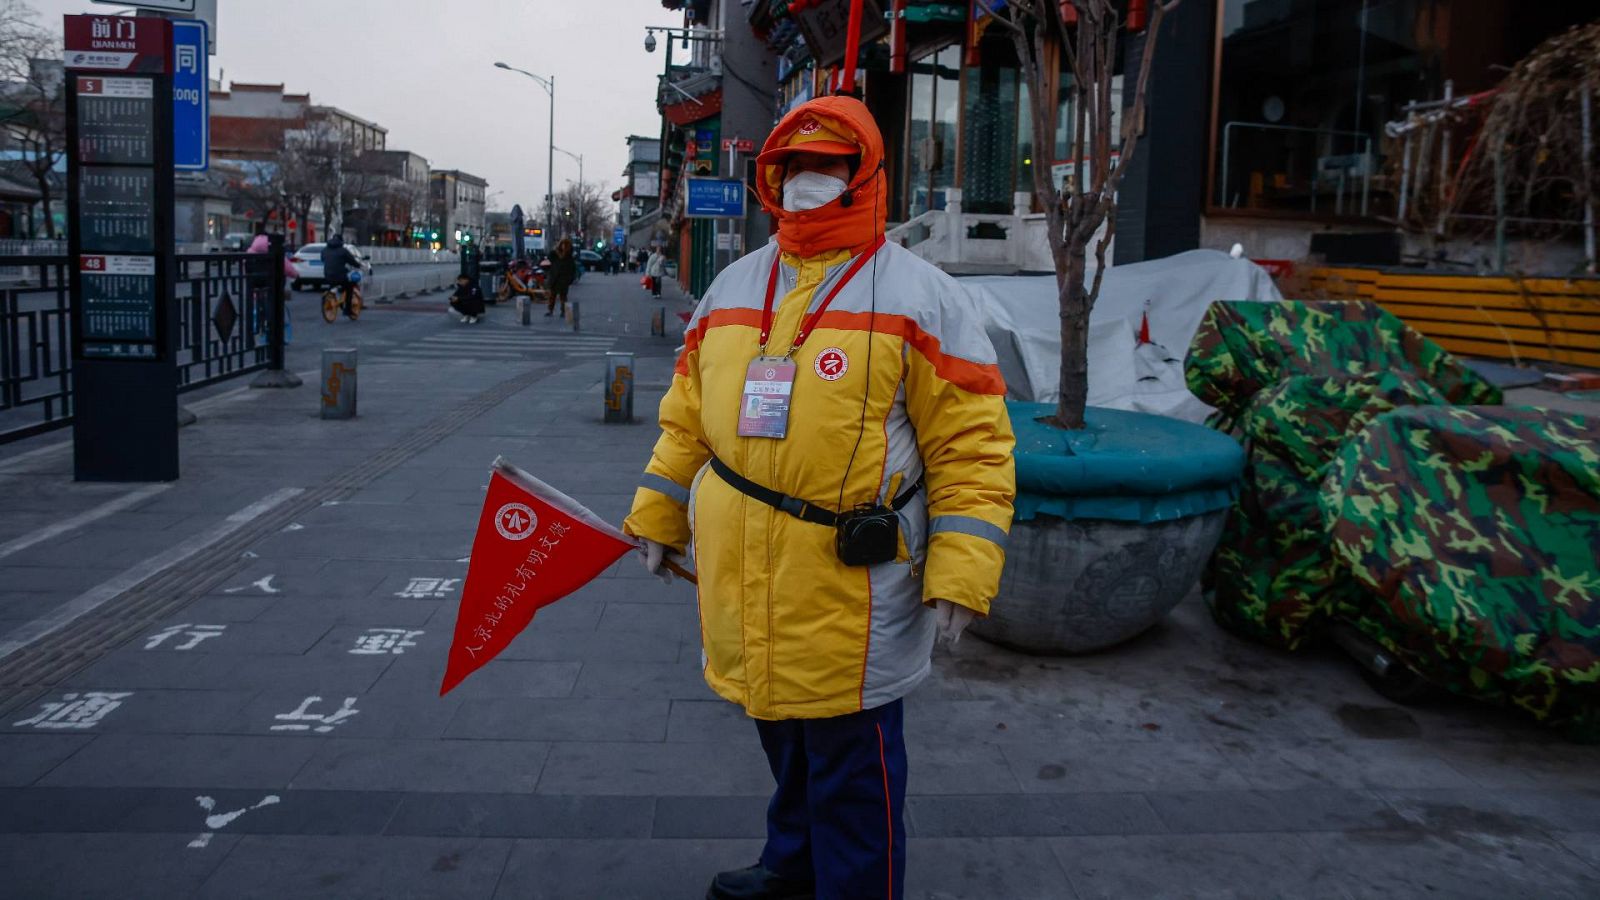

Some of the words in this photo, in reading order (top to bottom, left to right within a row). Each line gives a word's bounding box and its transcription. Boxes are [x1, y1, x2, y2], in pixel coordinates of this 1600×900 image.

[92, 18, 136, 39] 前门
[176, 45, 197, 74] 同
[86, 81, 94, 91] 5
[85, 258, 101, 269] 48
